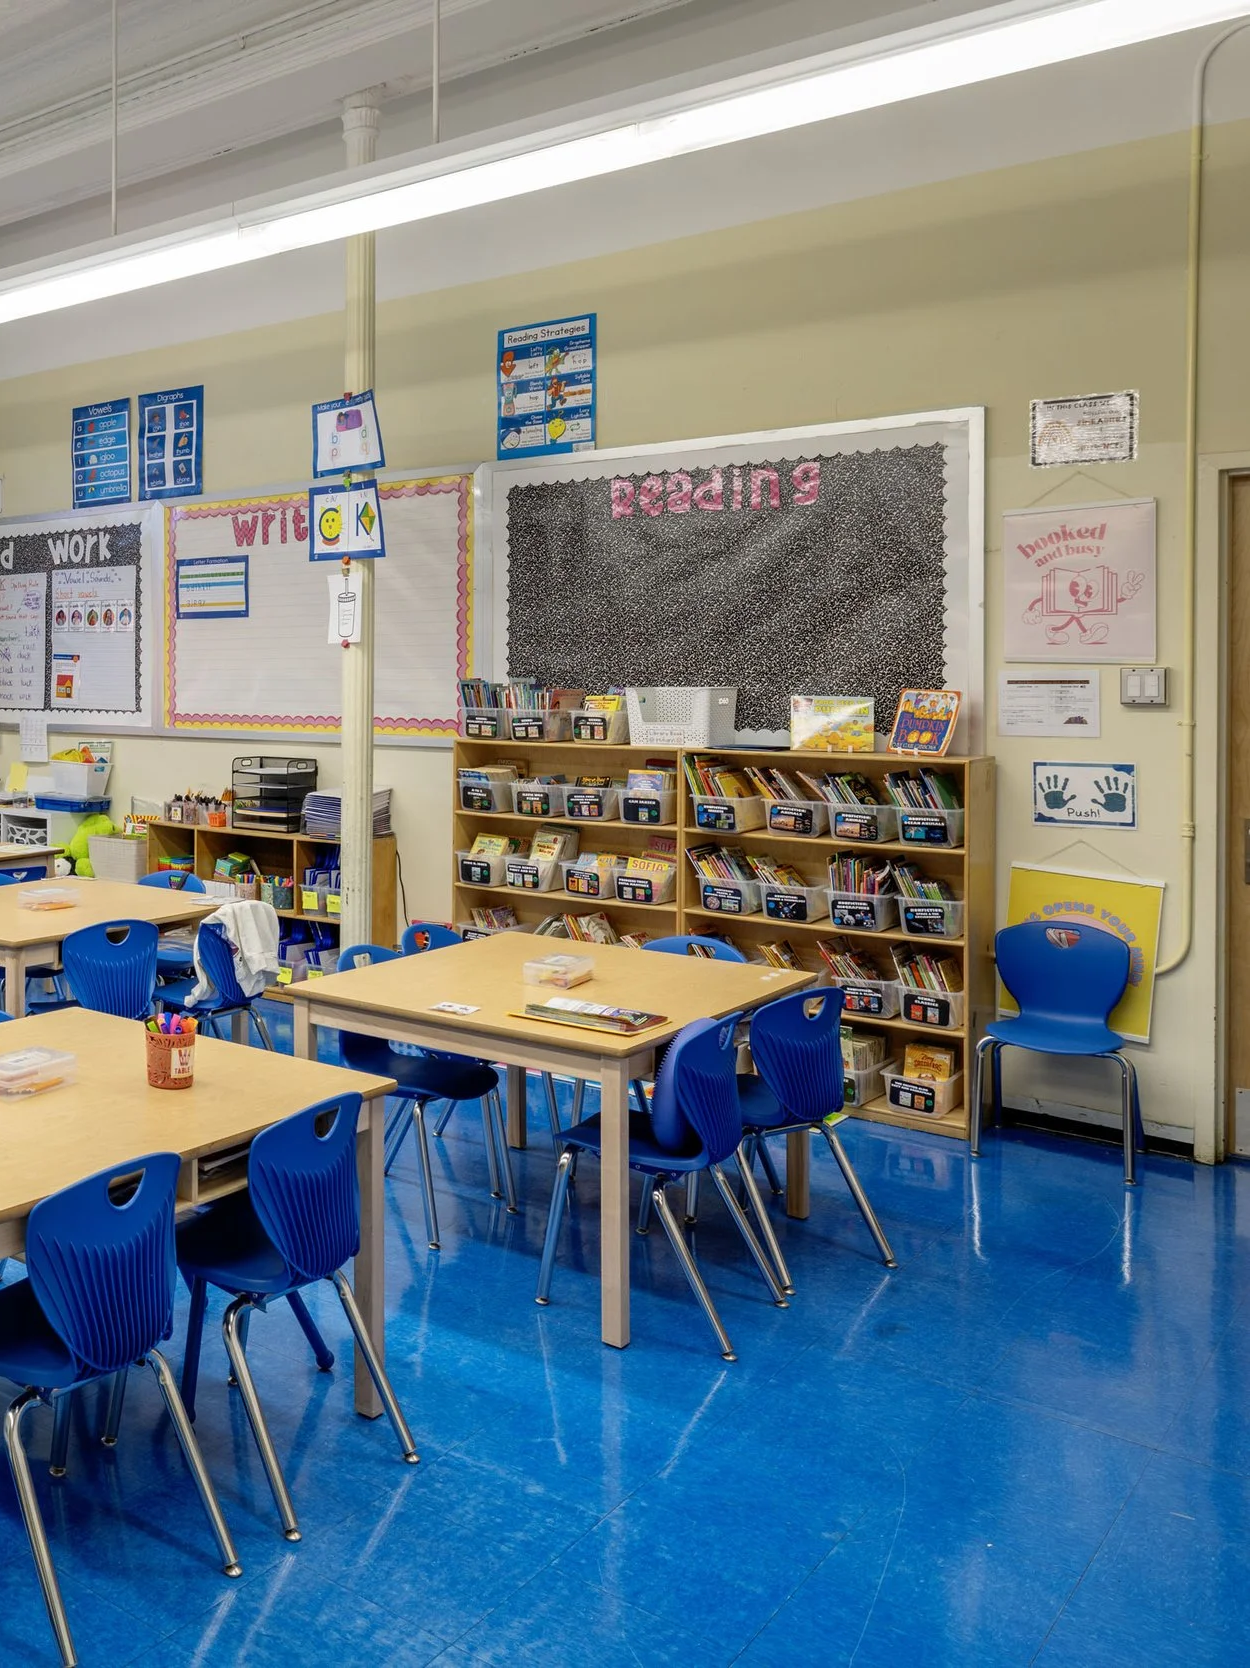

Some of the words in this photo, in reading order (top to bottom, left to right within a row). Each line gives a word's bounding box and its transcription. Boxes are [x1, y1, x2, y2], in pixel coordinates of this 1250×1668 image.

[507, 332, 538, 344] Reading
[540, 325, 586, 338] Strategies
[157, 391, 184, 403] Digraphs
[88, 404, 112, 416] Vowels
[98, 419, 117, 430] apple
[99, 436, 116, 447] edge
[332, 432, 338, 444] b
[100, 453, 116, 464] igloo
[100, 468, 125, 480] octopus
[100, 484, 127, 496] umbrella
[1016, 522, 1108, 560] booked
[1034, 547, 1064, 568] and
[1065, 543, 1105, 559] busy
[64, 572, 85, 585] Vowel
[901, 718, 946, 732] PUMPKIN
[897, 728, 942, 746] BOOK
[1066, 806, 1102, 819] Push!
[632, 860, 664, 872] SOFIA
[1042, 900, 1095, 916] OPENS
[1100, 908, 1137, 943] YOUR
[174, 1066, 190, 1074] TABLE
